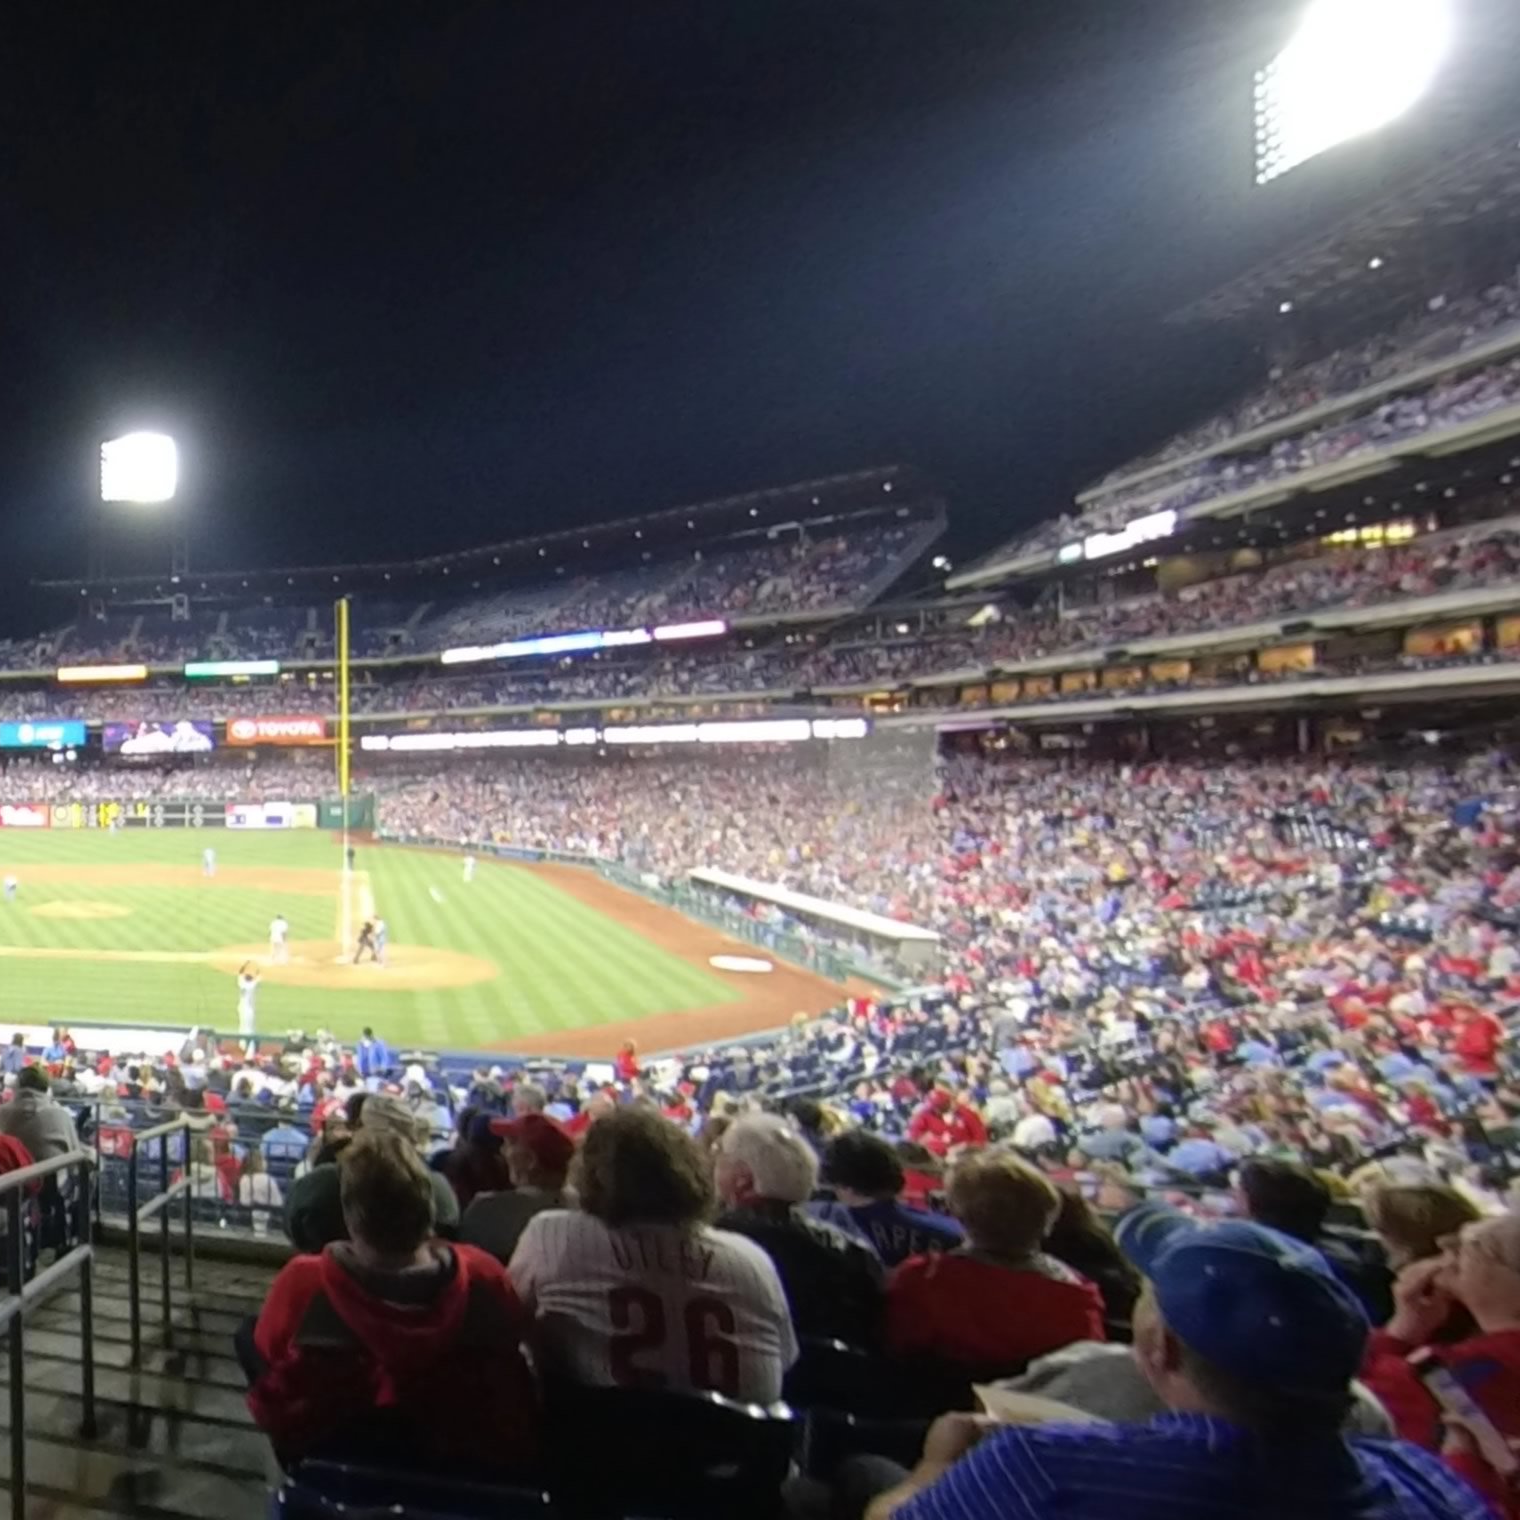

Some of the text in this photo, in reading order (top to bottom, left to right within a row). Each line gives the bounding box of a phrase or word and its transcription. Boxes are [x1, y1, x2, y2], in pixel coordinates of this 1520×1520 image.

[257, 720, 321, 738] TOYOTA
[609, 1232, 716, 1281] UTLEY
[608, 1286, 740, 1400] 26
